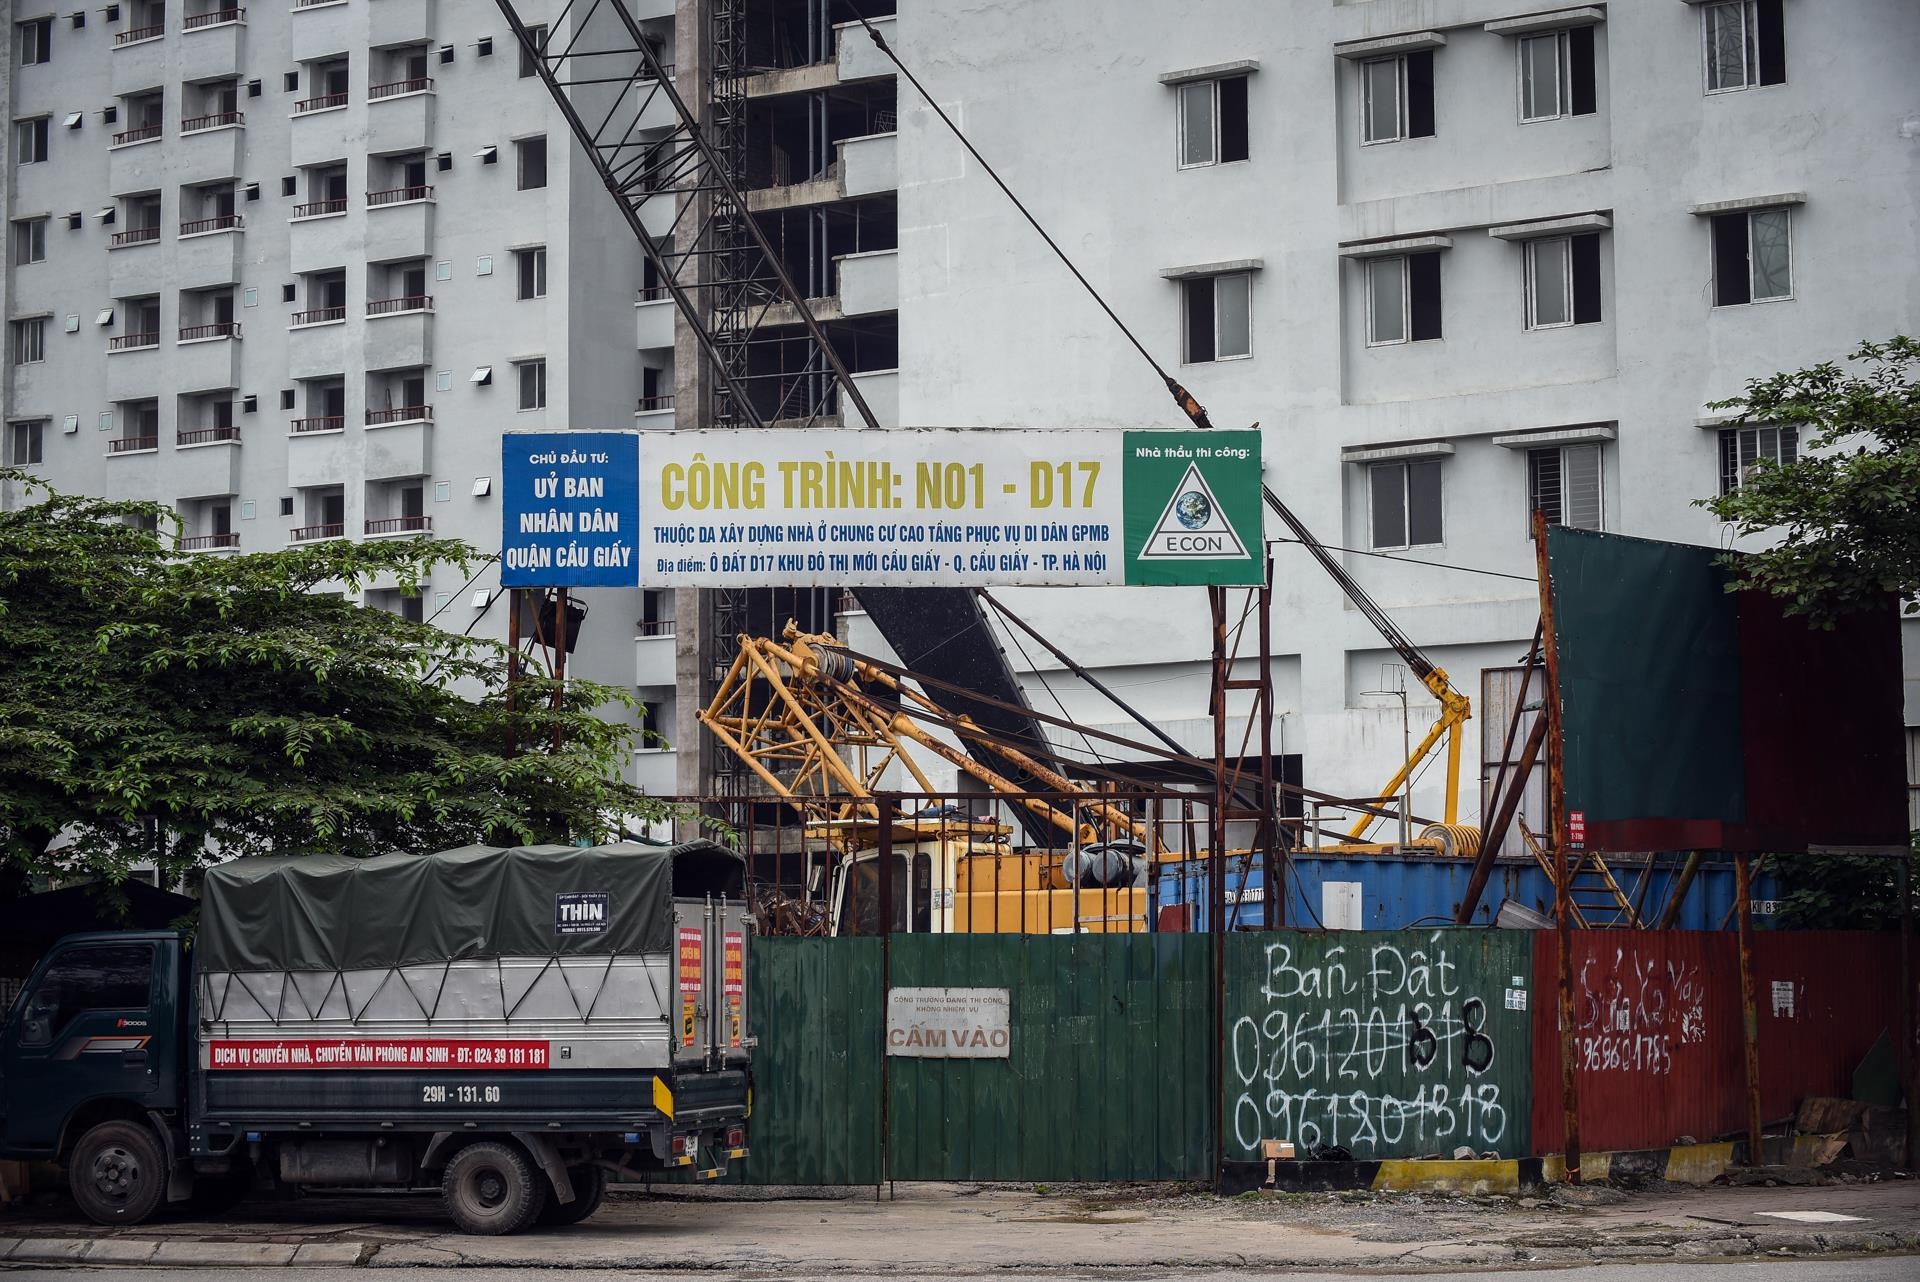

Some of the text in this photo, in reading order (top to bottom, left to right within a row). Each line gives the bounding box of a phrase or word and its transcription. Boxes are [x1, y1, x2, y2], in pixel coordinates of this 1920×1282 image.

[529, 449, 609, 464] CHỦ ĐẦU TƯ:
[1136, 447, 1161, 458] Nhà
[1196, 447, 1212, 458] thi
[1214, 446, 1250, 460] công:
[534, 471, 604, 499] UỶ BAN
[661, 452, 766, 511] CÔNG
[778, 450, 902, 509] TRÌNH:
[1003, 483, 1017, 494] -
[1030, 460, 1101, 509] D17
[520, 507, 619, 533] NHÂN DÂN
[654, 519, 1110, 547] THUỘC DA XÂY DỰNG NHÀ Ở CHUNG CƯ CAO TẦNG PHỤC VỤ DI DÂN GPMB
[506, 539, 631, 572] QUẬN CẦU GIẤY
[1166, 536, 1222, 553] ECON
[656, 558, 674, 576] Địa
[676, 555, 706, 573] điểm:
[709, 551, 719, 573] Ô
[721, 549, 747, 573] ĐẤT
[750, 554, 775, 572] D17
[778, 554, 804, 572] KHU
[807, 550, 825, 572] ĐÔ
[828, 554, 849, 575] THỊ
[852, 550, 878, 572] MỚI
[881, 548, 908, 572] CẦU
[911, 548, 941, 572] GIẤY
[953, 554, 966, 574] Q.
[969, 548, 996, 572] CẦU
[999, 548, 1029, 572] GIẤY
[1041, 554, 1059, 571] TP.
[1062, 550, 1081, 571] HÀ
[1083, 550, 1107, 575] NỘI
[560, 899, 603, 921] THÌN
[1367, 931, 1459, 1001] Đất
[888, 1021, 1009, 1048] CẤM VÀO
[214, 1047, 237, 1067] DỊCH
[238, 1048, 251, 1067] VỤ
[252, 1042, 289, 1064] CHUYỂN
[291, 1044, 314, 1065] NHÀ,
[315, 1041, 351, 1063] CHUYỂN
[354, 1043, 374, 1062] VĂN
[375, 1043, 408, 1063] PHÒNG
[409, 1046, 424, 1063] AN
[425, 1046, 449, 1063] SINH
[457, 1047, 473, 1063] ĐT:
[474, 1047, 493, 1064] 024
[494, 1047, 507, 1064] 39
[508, 1047, 525, 1064] 181
[528, 1047, 545, 1064] 181
[423, 1085, 446, 1103] 29H
[484, 1085, 501, 1103] 60
